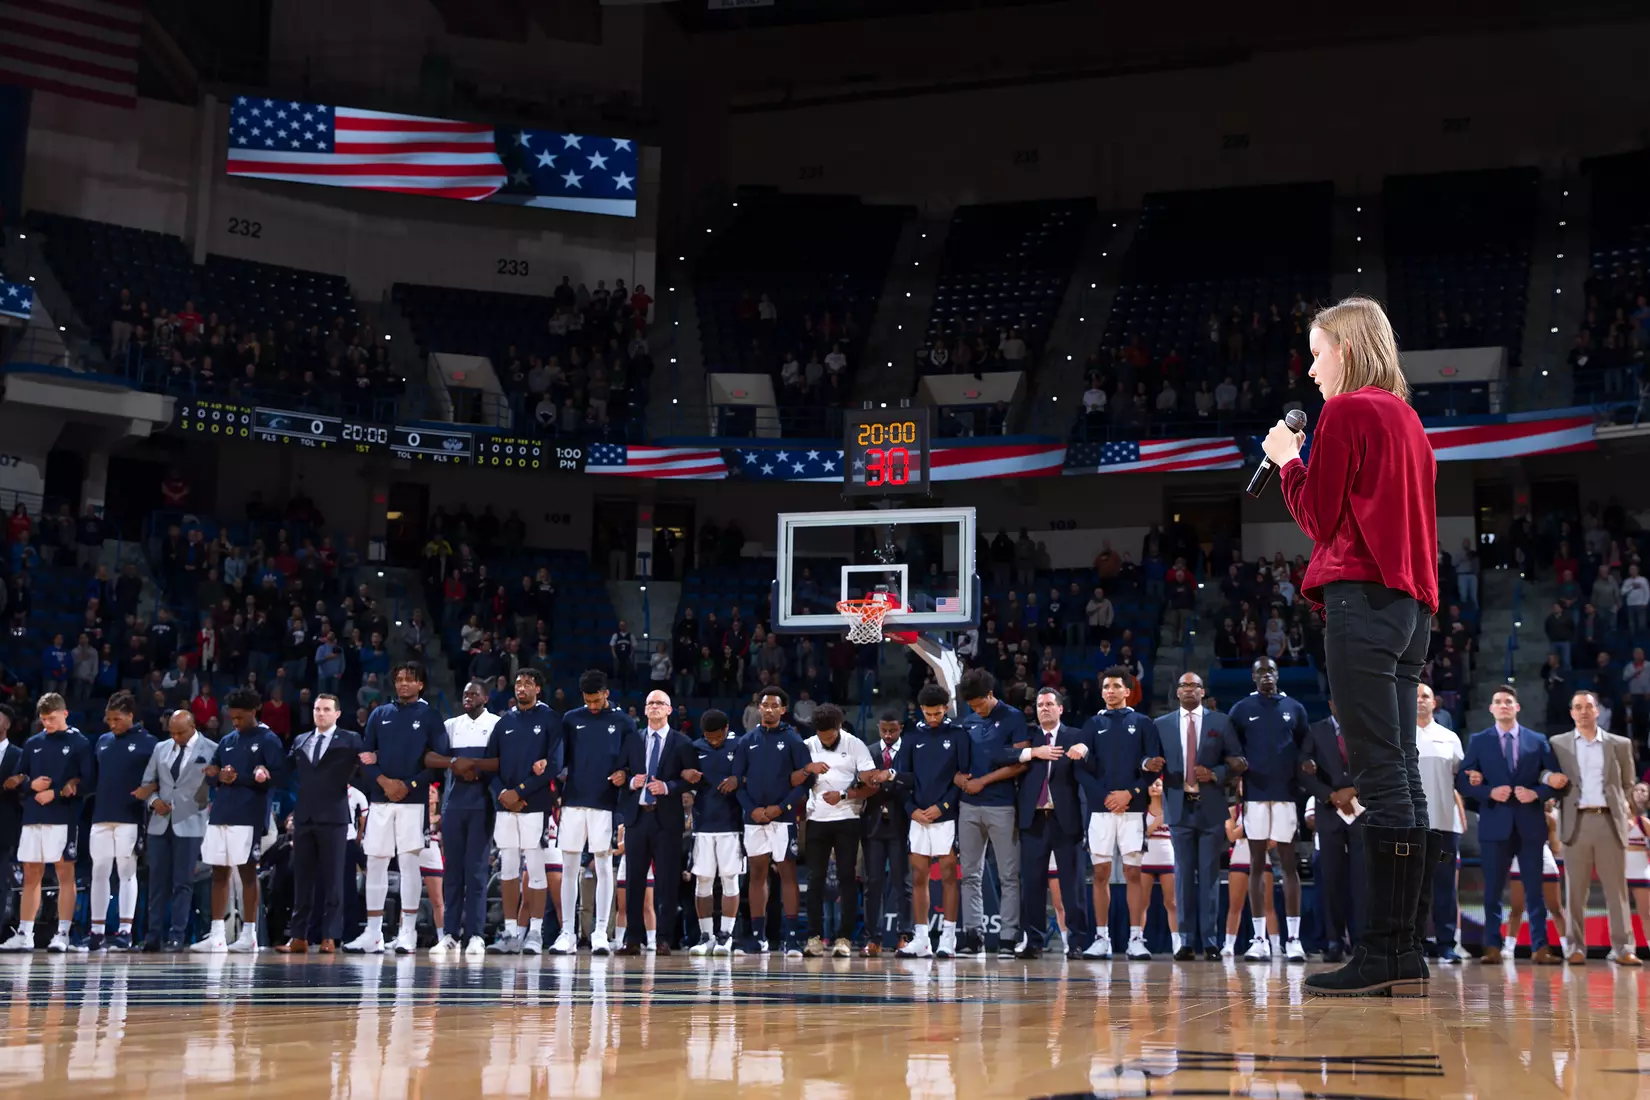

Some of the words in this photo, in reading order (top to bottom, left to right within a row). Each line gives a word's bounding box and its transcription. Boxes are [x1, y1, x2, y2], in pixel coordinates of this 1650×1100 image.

[228, 217, 262, 239] 232
[497, 258, 529, 277] 233
[182, 406, 189, 417] 2
[197, 408, 206, 418] 0
[212, 411, 220, 420] 0
[226, 413, 235, 422] 0
[241, 415, 249, 424] 0
[181, 420, 188, 429] 3
[196, 422, 205, 431] 0
[211, 423, 219, 433] 0
[225, 425, 234, 435] 0
[240, 427, 248, 437] 0
[311, 420, 324, 434] 0
[858, 421, 915, 446] 20:00
[262, 433, 276, 442] FLS
[283, 436, 289, 444] 0
[342, 424, 388, 444] 20:00
[408, 433, 420, 447] 0
[300, 438, 315, 447] TOL
[355, 444, 370, 452] 1ST
[397, 451, 412, 459] TOL
[480, 443, 484, 452] 1
[492, 444, 500, 453] 0
[505, 445, 513, 454] 0
[519, 446, 526, 455] 0
[532, 447, 540, 456] 0
[556, 447, 581, 459] 1:00
[433, 455, 448, 463] FLS
[478, 456, 484, 464] 3
[492, 456, 499, 465] 0
[505, 457, 512, 466] 0
[518, 458, 526, 467] 0
[532, 459, 539, 468] 0
[560, 460, 576, 470] PM
[866, 447, 909, 487] 30
[1049, 519, 1077, 531] 109
